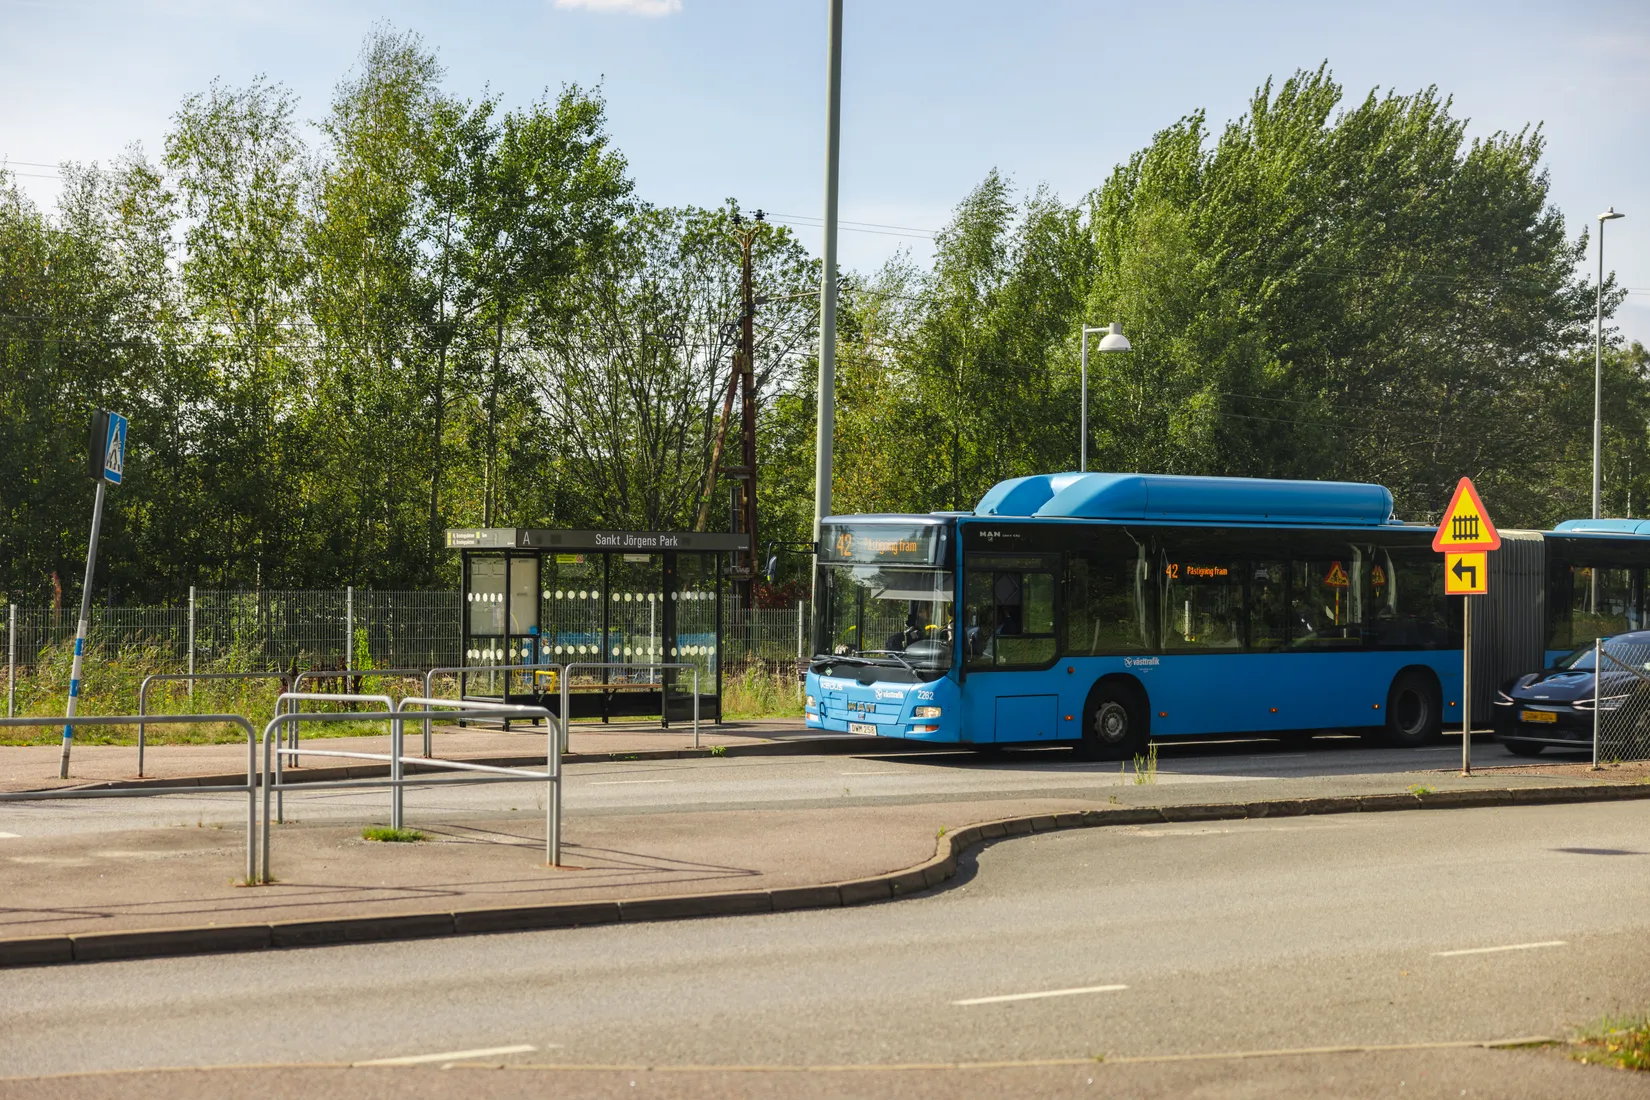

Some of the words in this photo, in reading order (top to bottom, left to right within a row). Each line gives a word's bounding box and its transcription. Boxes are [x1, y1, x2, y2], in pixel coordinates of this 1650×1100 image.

[522, 531, 531, 545] A
[595, 533, 621, 546] Sankt
[623, 534, 657, 549] Jörgens
[659, 535, 678, 547] Park
[836, 533, 853, 557] 42
[899, 539, 917, 552] fram
[1165, 563, 1179, 579] 42
[1186, 565, 1214, 578] Påstigning
[1214, 566, 1228, 576] fram
[1133, 656, 1160, 666] västtrafik
[847, 700, 876, 713] MAN
